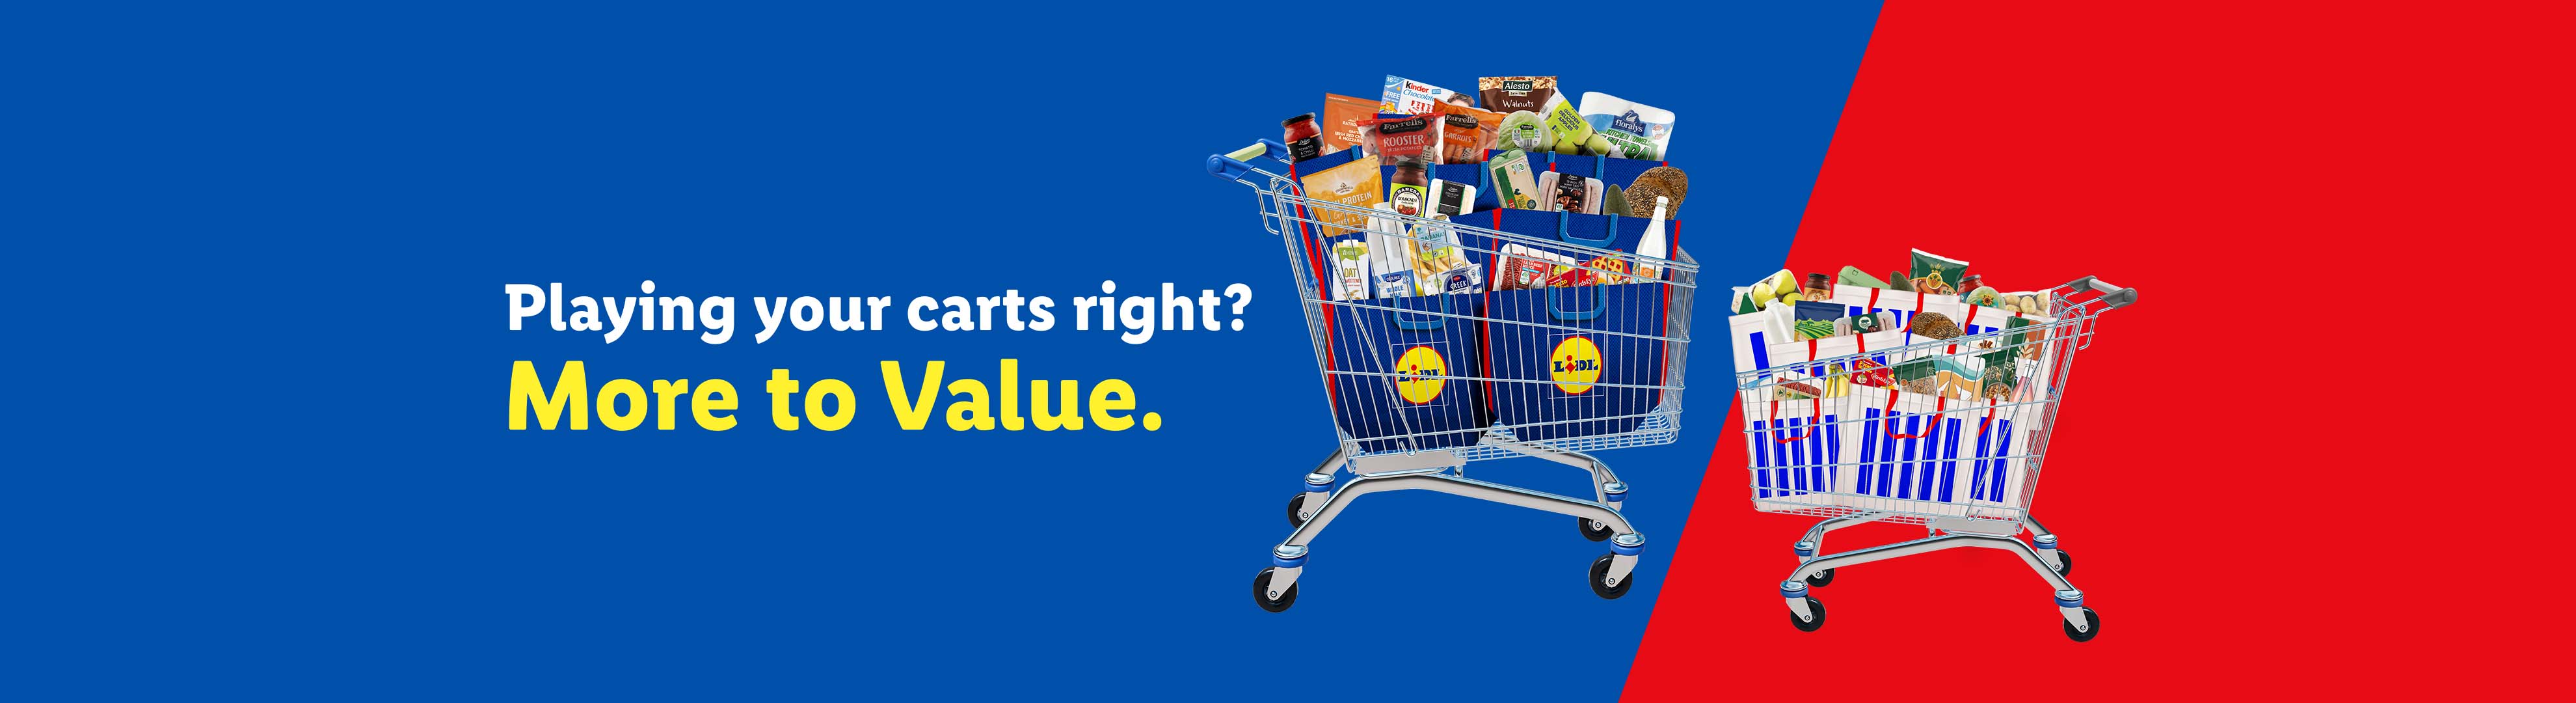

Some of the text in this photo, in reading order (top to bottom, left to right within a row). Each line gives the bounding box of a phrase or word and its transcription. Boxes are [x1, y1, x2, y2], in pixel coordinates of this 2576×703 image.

[1386, 91, 1401, 100] FREE
[1503, 99, 1534, 108] Walnuts
[1559, 110, 1579, 130] DELICIOUS
[1564, 109, 1580, 124] GOLDEN
[1558, 117, 1573, 131] APPLES
[1615, 119, 1643, 133] floralys
[1384, 134, 1424, 148] ROOSTER
[1605, 128, 1651, 146] KITCHEN TOWELS
[1343, 191, 1372, 205] PROTEIN
[1397, 187, 1421, 197] BARESA
[1344, 268, 1357, 277] OAT
